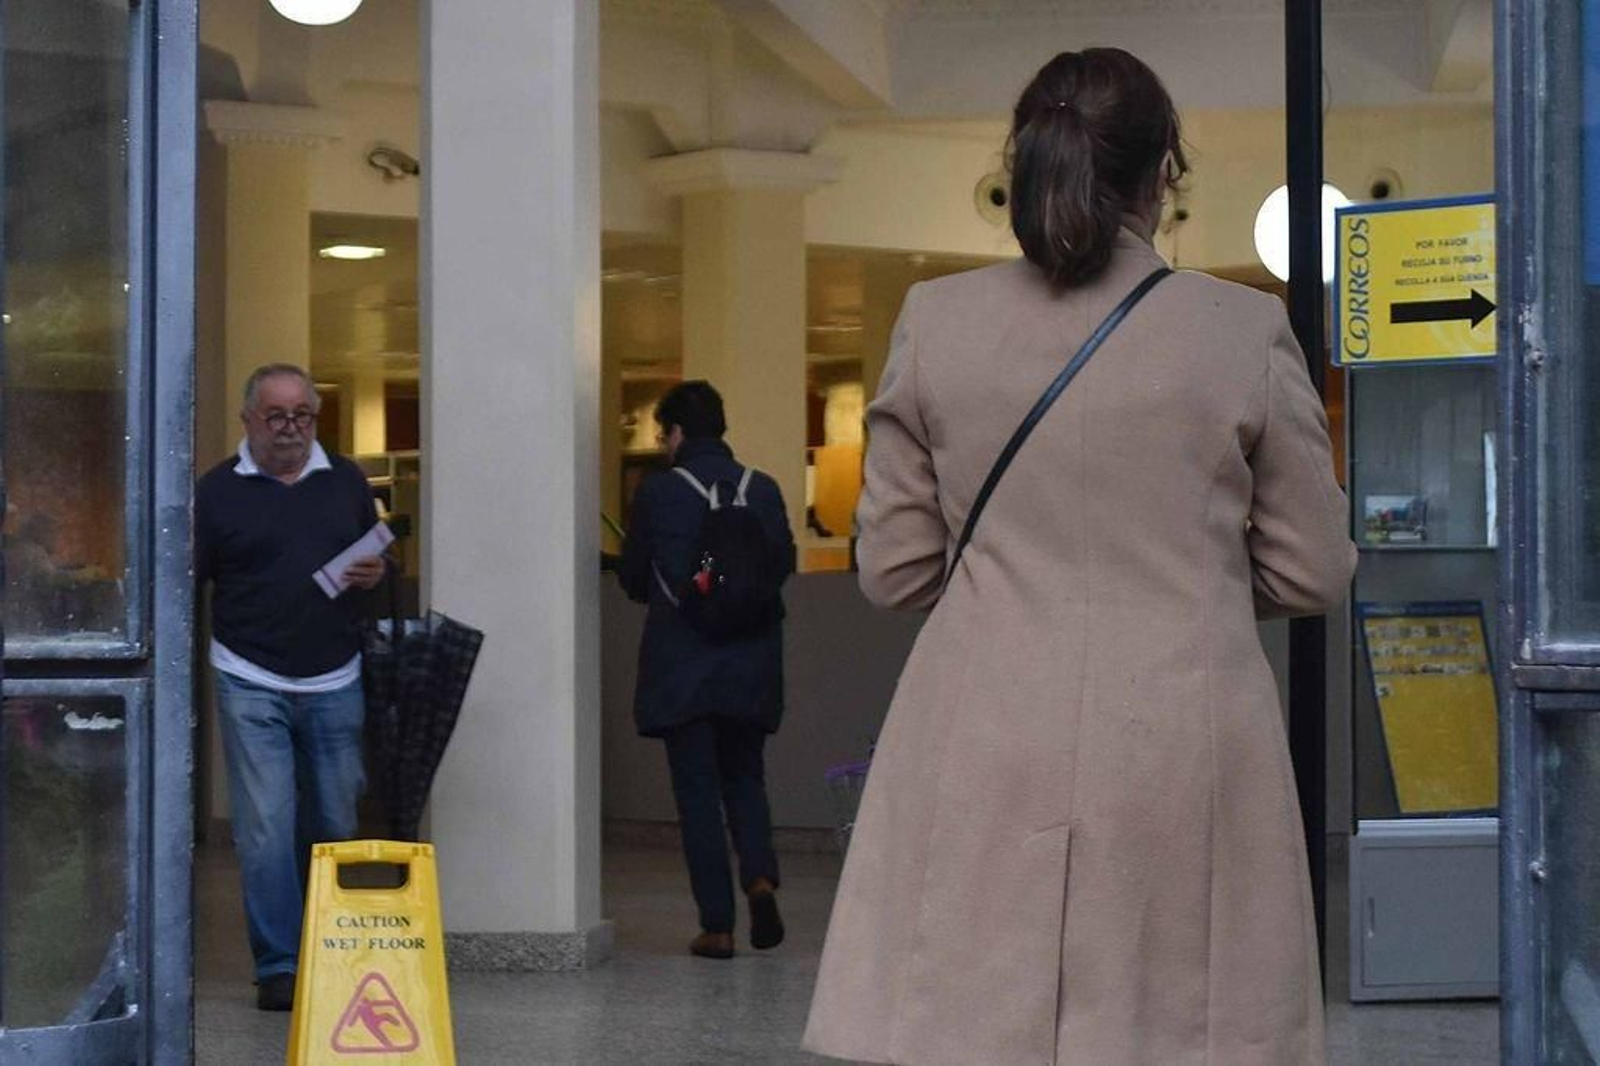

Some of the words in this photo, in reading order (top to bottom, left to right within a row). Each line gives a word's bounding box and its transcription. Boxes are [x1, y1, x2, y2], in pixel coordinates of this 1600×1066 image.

[1416, 239, 1434, 249] POR
[1438, 237, 1468, 247] FAVOR
[1344, 218, 1370, 359] CORREOS
[336, 915, 411, 928] CAUTION
[323, 937, 358, 950] WET
[368, 937, 426, 950] FLOOR
